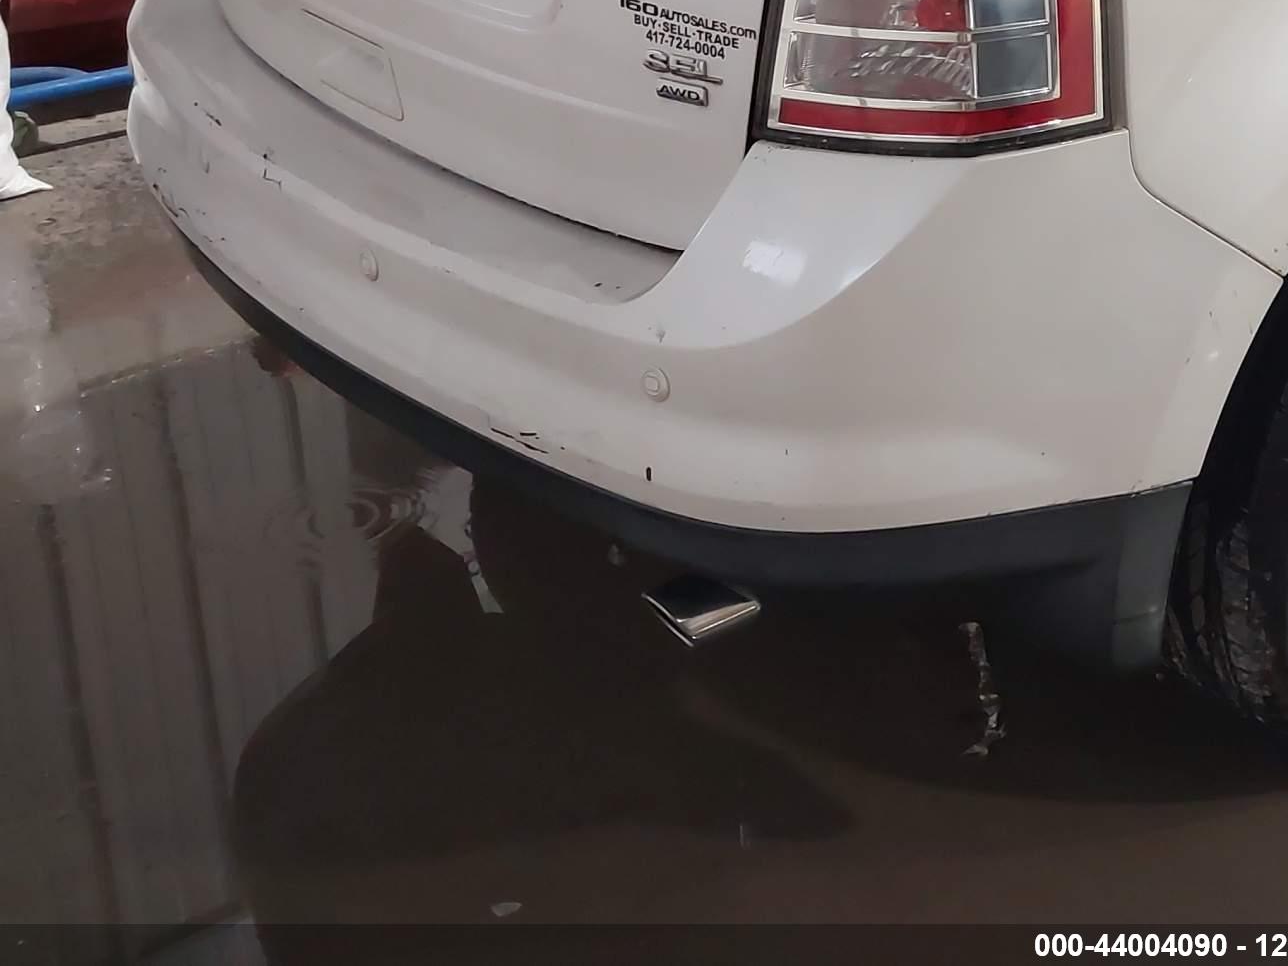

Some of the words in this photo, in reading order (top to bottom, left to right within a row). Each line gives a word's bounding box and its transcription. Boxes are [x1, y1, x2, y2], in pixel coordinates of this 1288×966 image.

[645, 29, 726, 60] 417-724-0004
[642, 48, 724, 86] SEL
[659, 84, 701, 102] AWD
